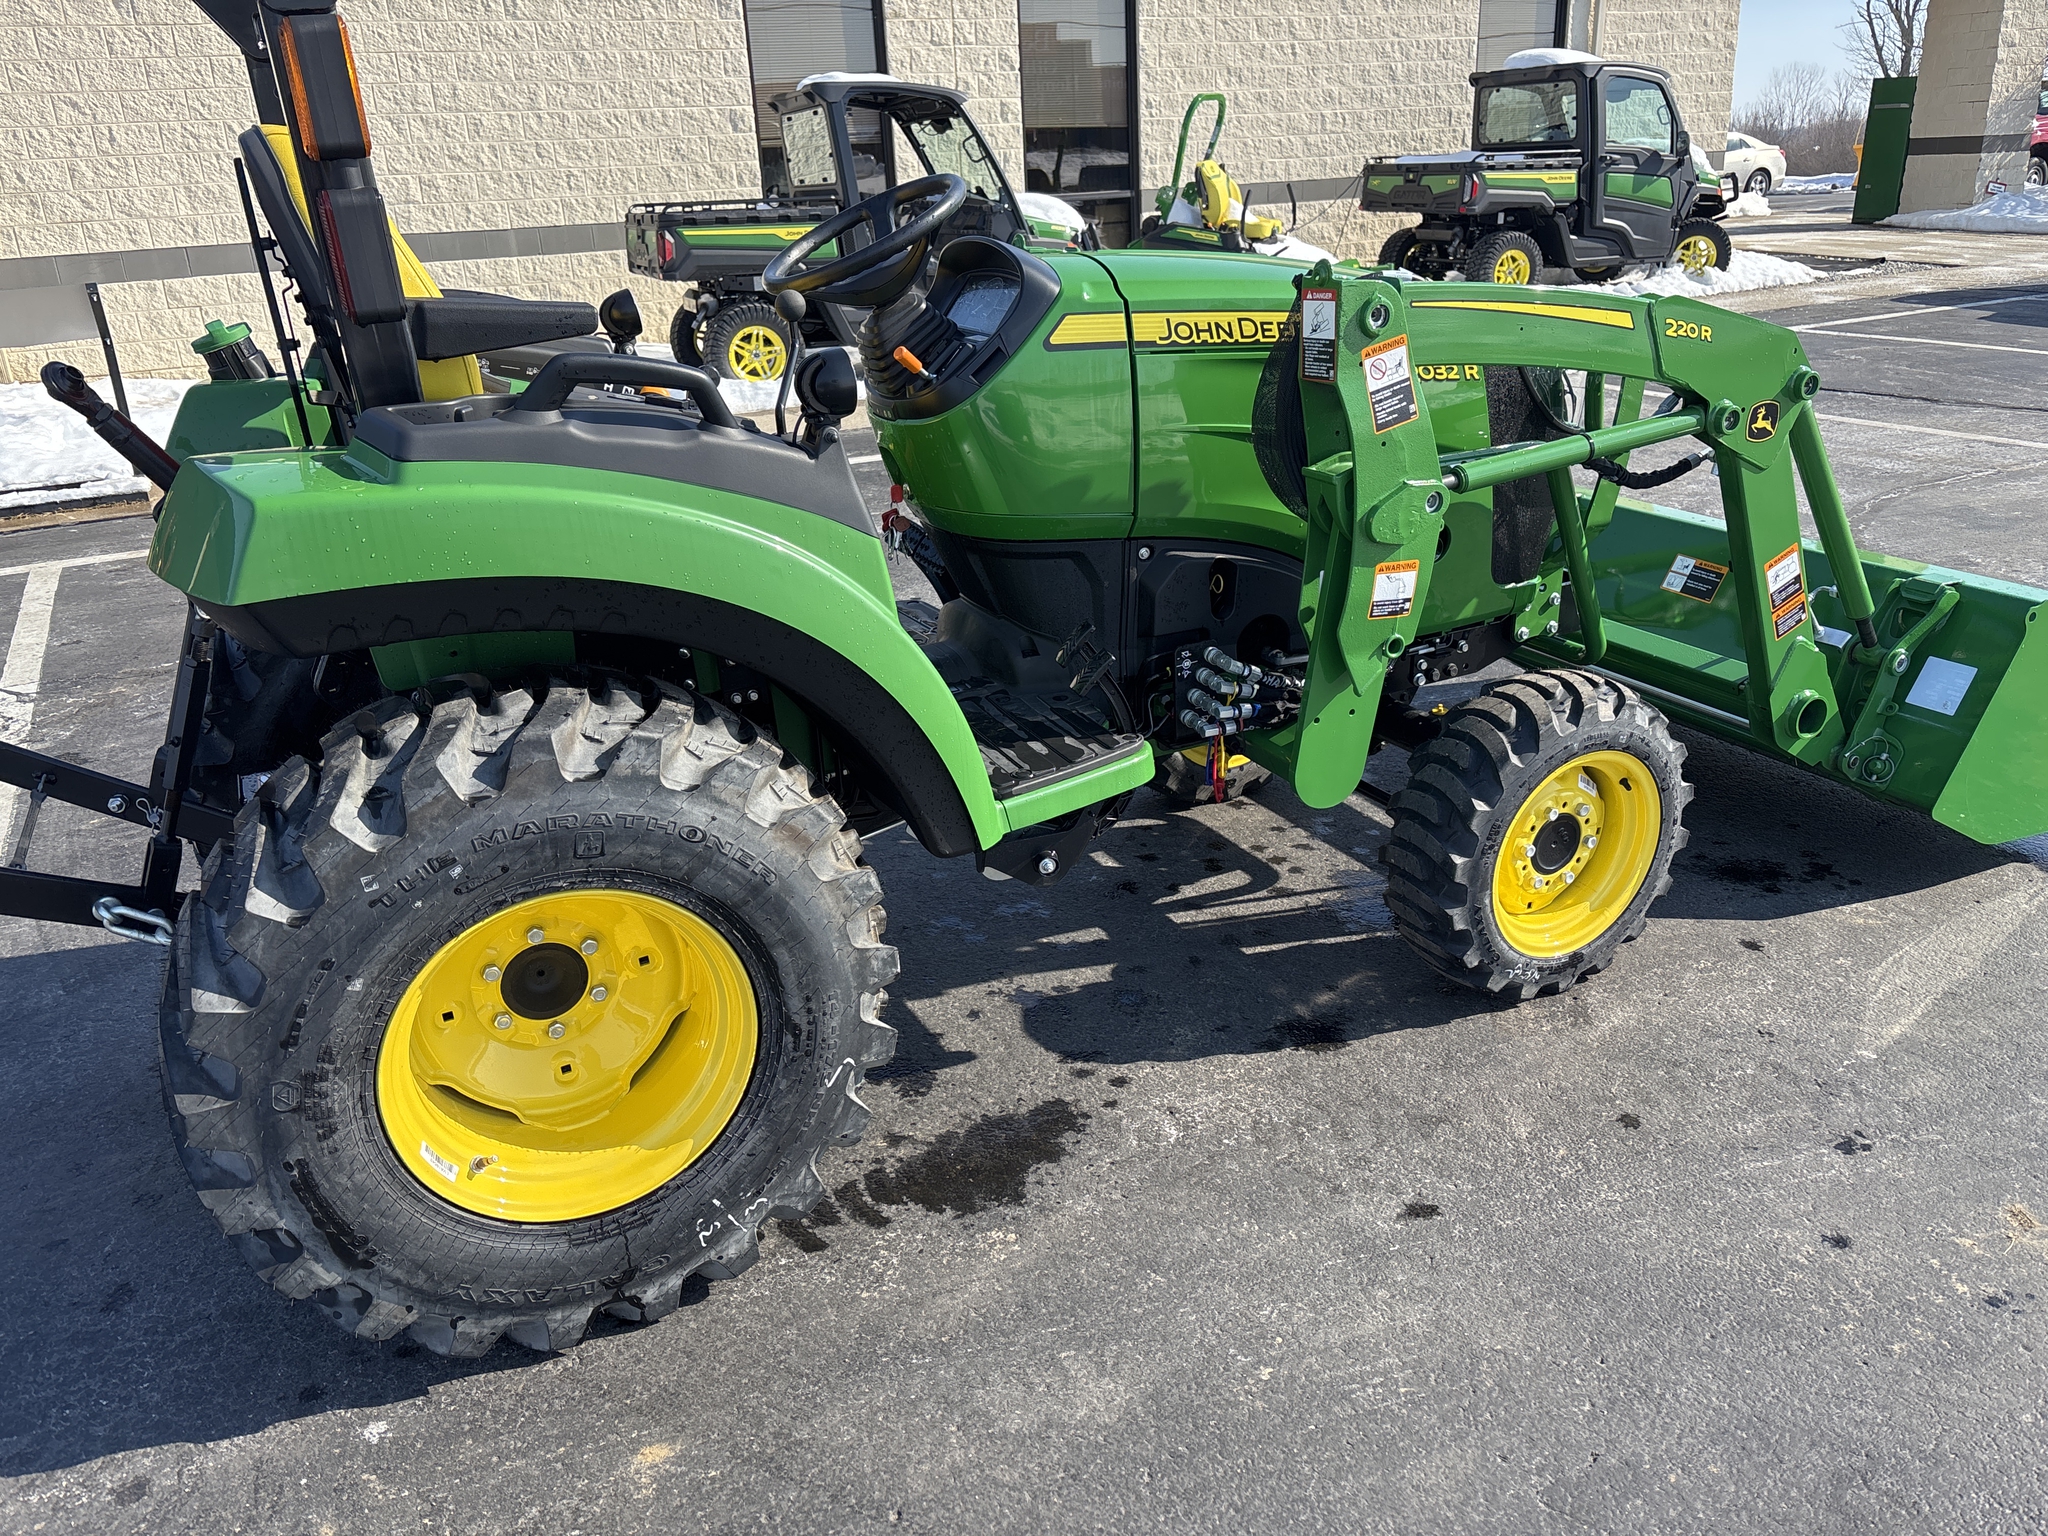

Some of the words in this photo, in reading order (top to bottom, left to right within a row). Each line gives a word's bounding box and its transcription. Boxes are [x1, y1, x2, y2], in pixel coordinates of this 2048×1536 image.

[1159, 317, 1232, 341] JOHN
[1665, 318, 1699, 339] 220
[1701, 325, 1712, 342] R
[1371, 337, 1405, 354] WARNING
[1415, 364, 1461, 381] 032
[1463, 364, 1480, 381] R
[1773, 547, 1795, 564] WARNING
[1385, 562, 1416, 571] WARNING
[1703, 563, 1723, 571] WARNING
[1781, 597, 1802, 613] WARNING
[368, 850, 459, 908] THE
[471, 812, 779, 886] MARATHONER
